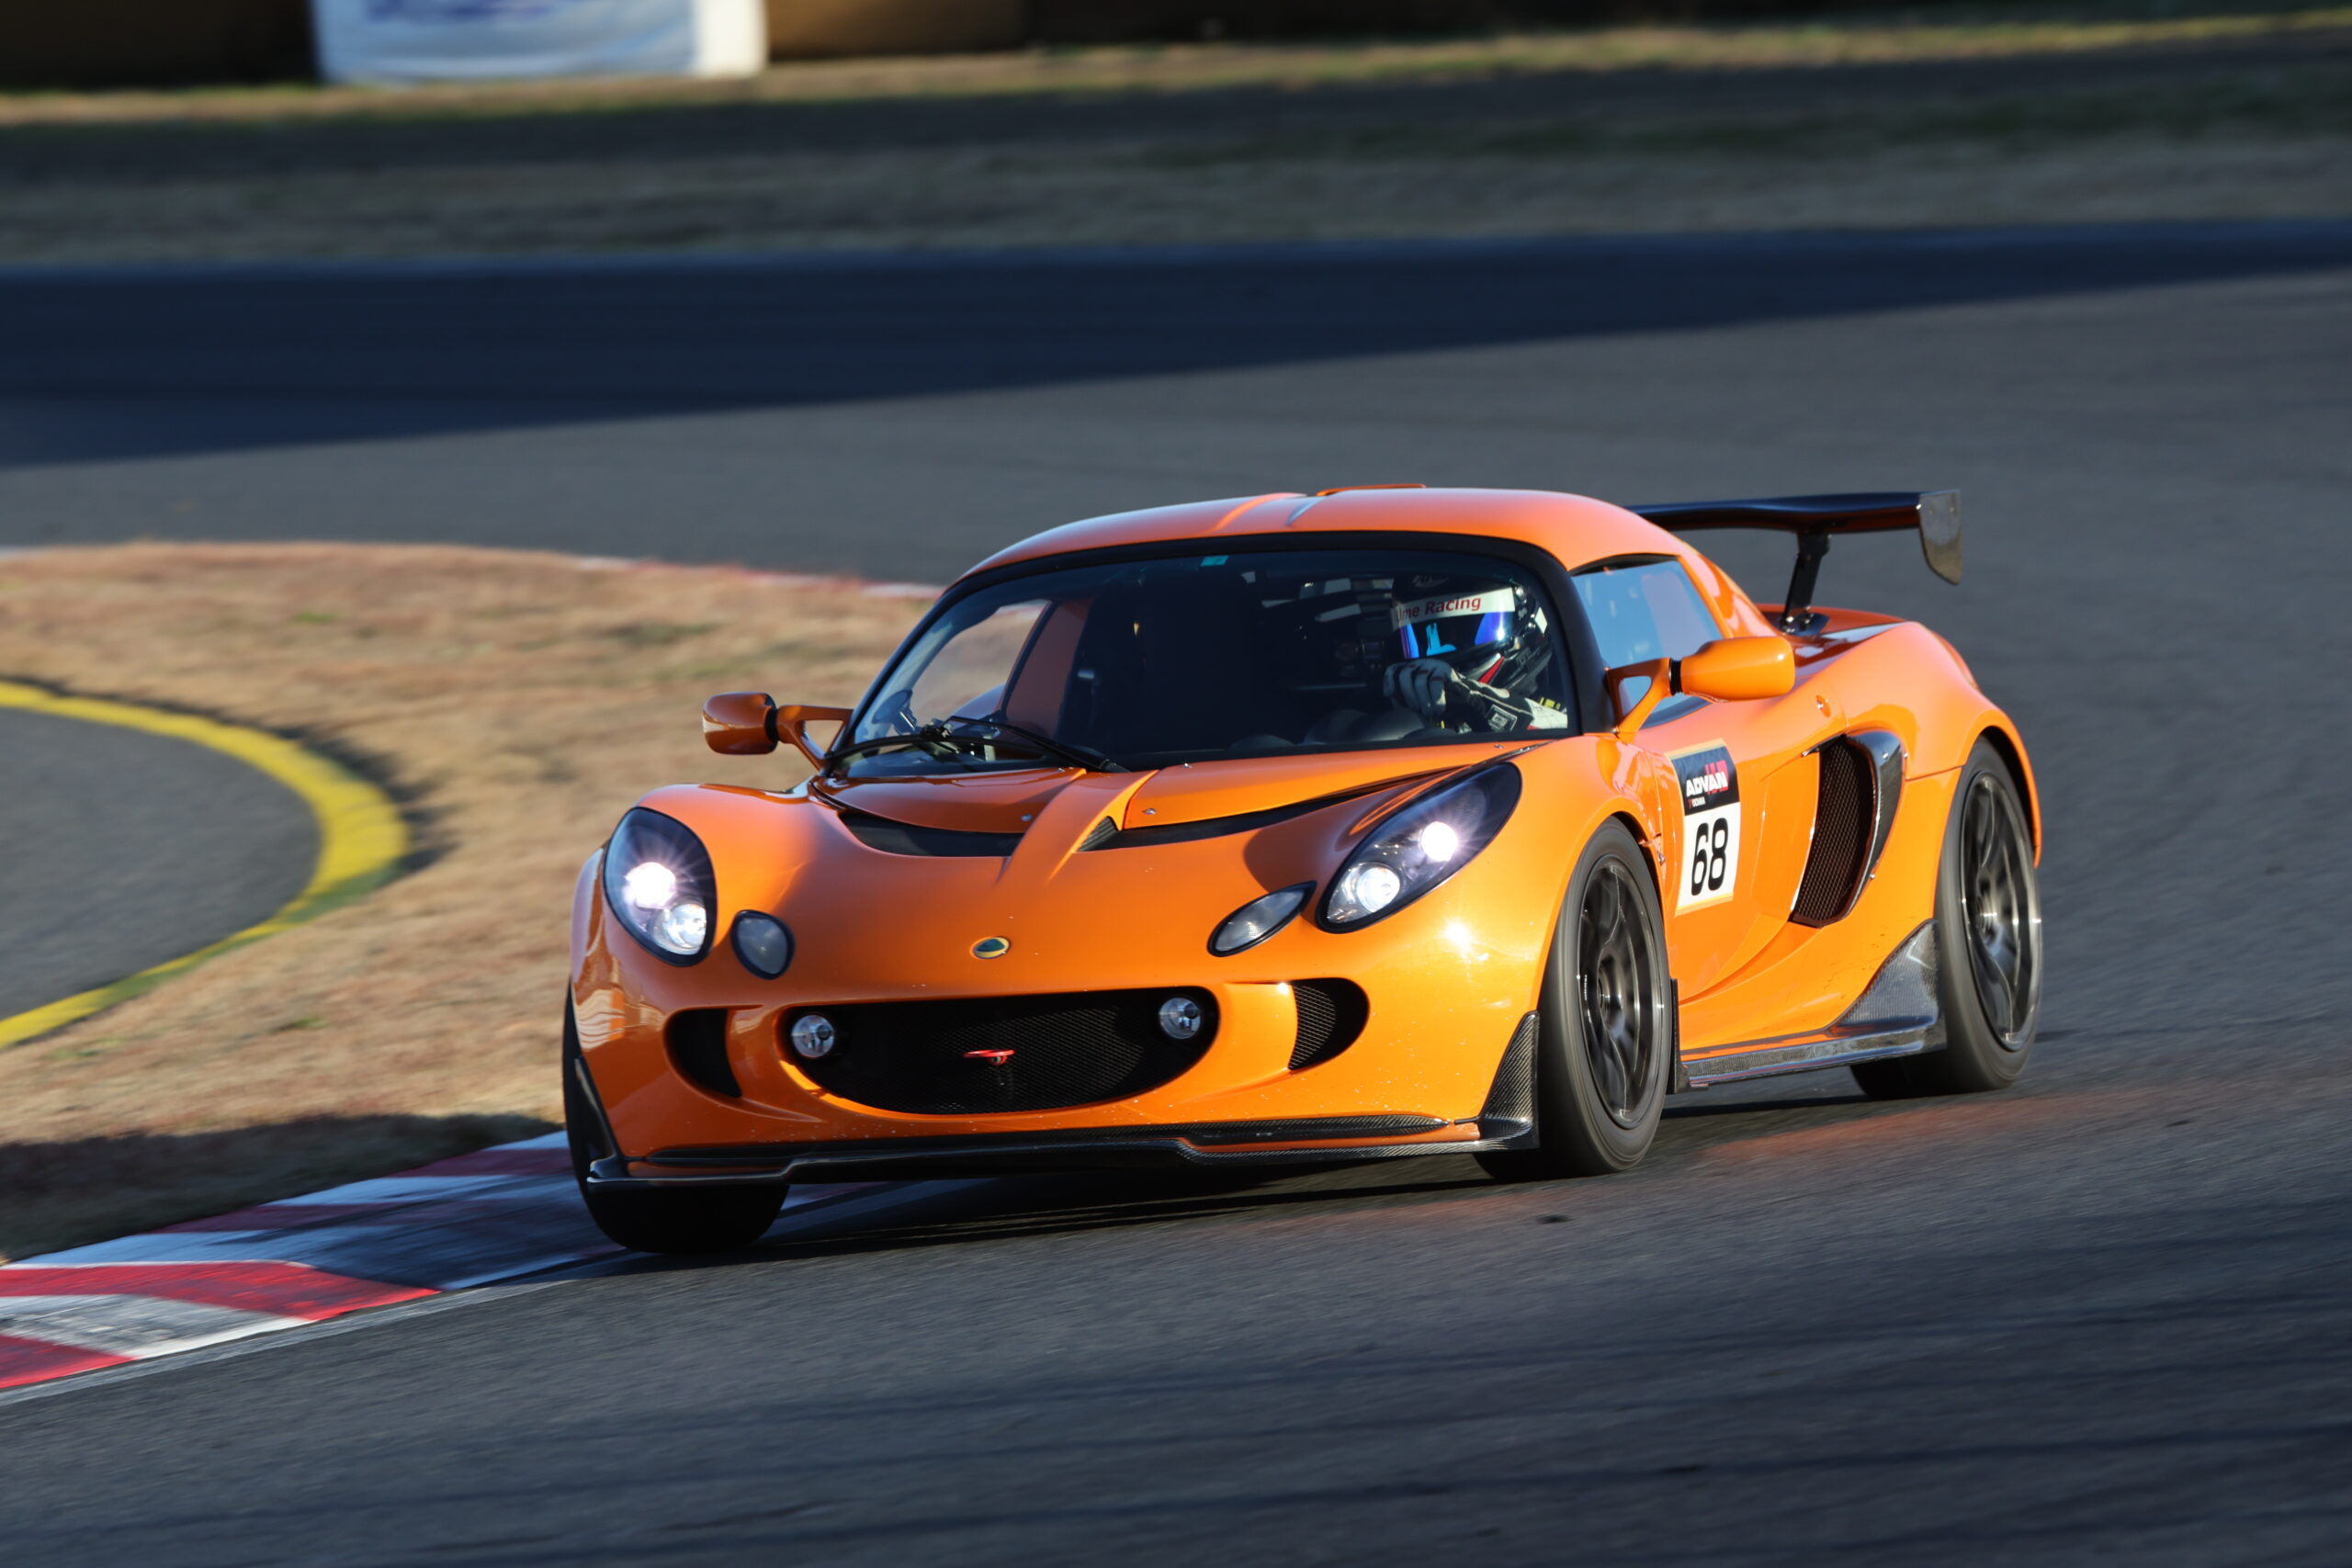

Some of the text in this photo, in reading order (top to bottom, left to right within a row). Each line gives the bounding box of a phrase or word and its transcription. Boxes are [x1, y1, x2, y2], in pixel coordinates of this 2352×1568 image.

[1425, 597, 1481, 615] Racing
[1686, 771, 1728, 797] ADVAN
[1691, 818, 1728, 896] 68
